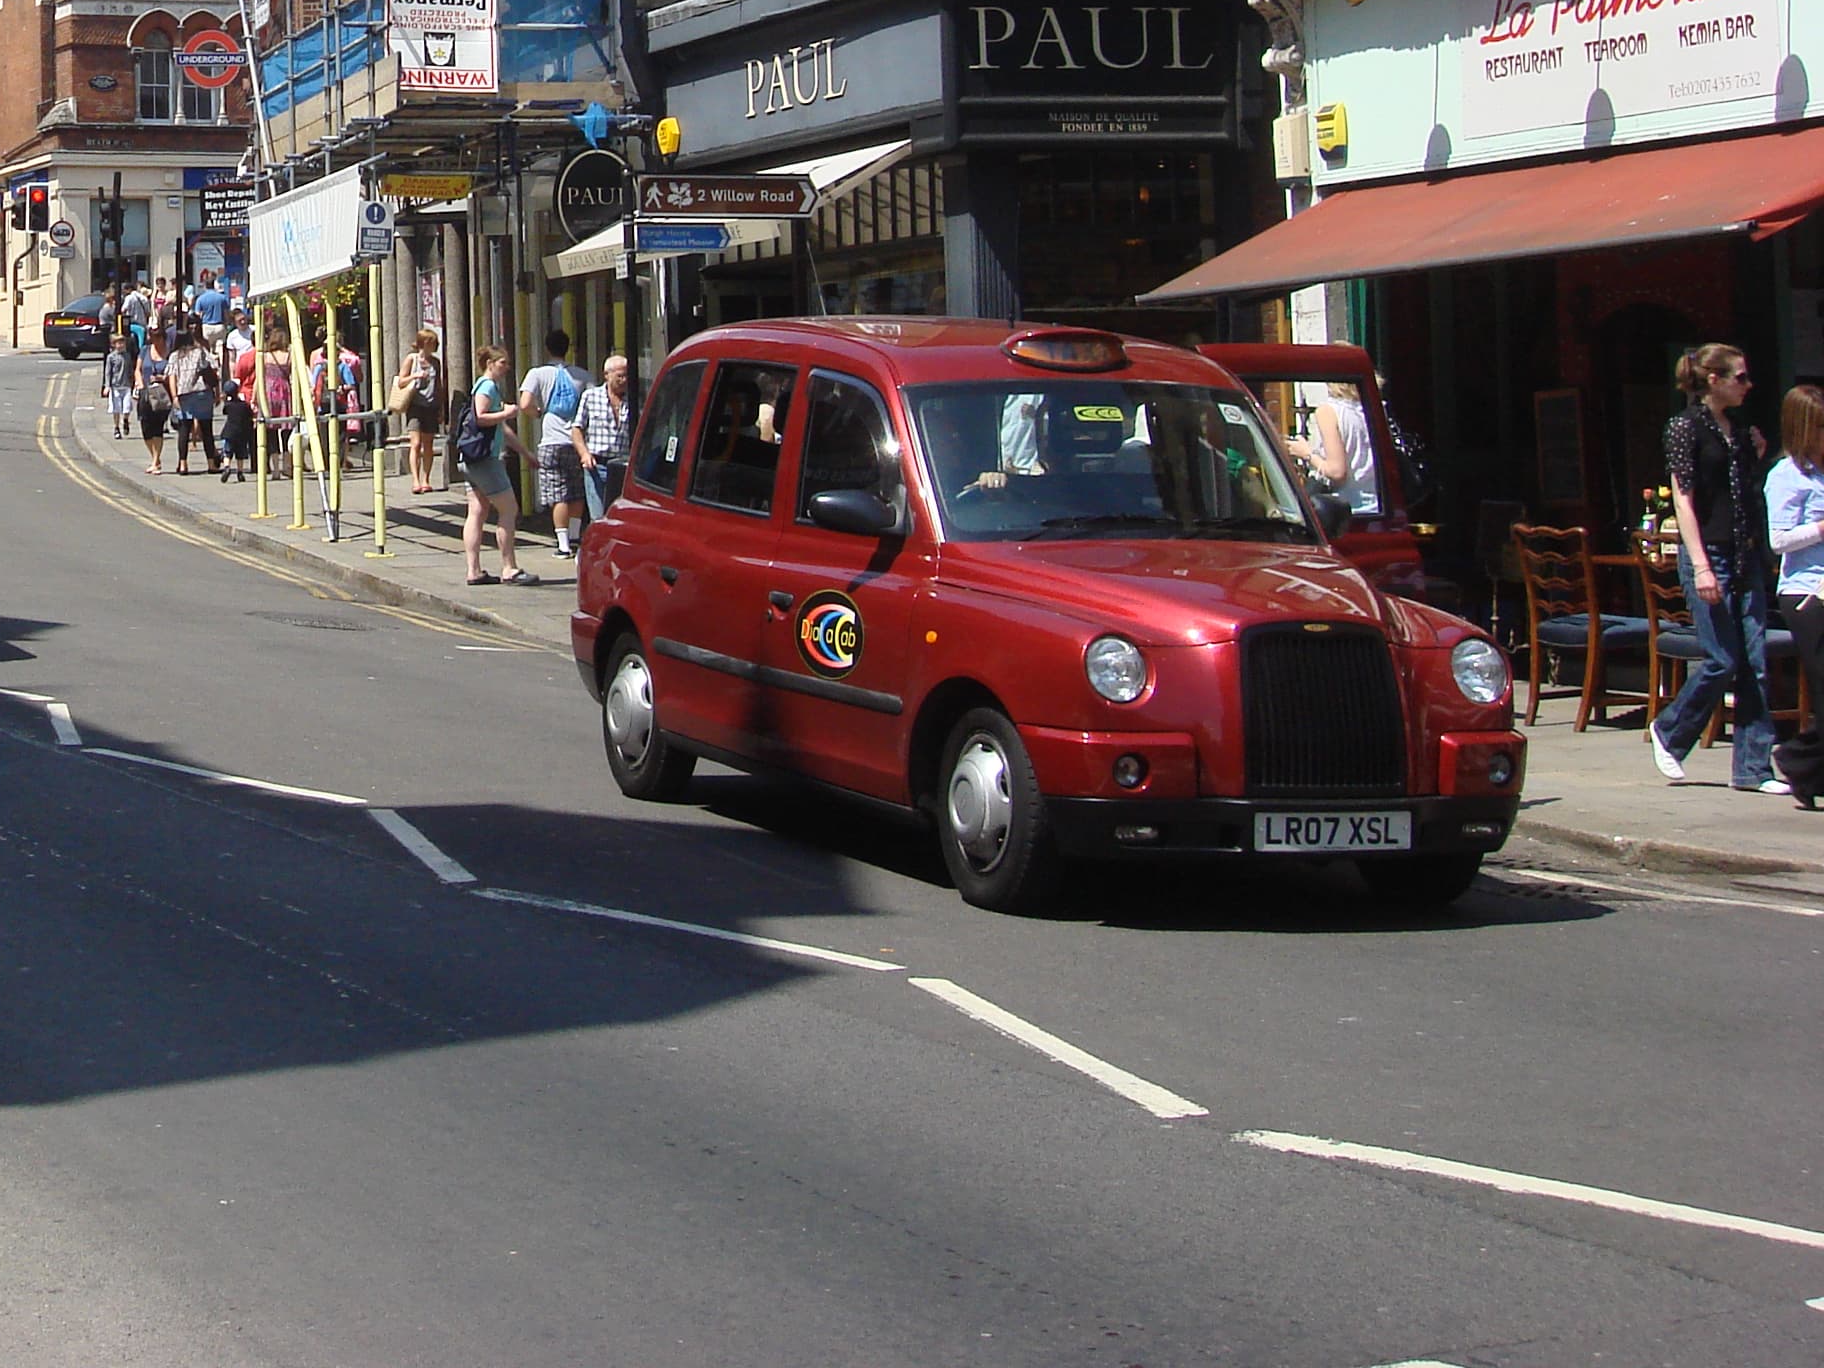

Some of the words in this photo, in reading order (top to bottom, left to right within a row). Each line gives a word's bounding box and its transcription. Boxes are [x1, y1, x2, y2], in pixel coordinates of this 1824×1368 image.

[410, 9, 466, 17] PROTECTED
[969, 6, 1214, 70] PAUL
[1726, 14, 1758, 42] BAR
[1584, 33, 1648, 62] TEAROOM
[178, 55, 245, 64] UNDERGROUND
[1485, 47, 1564, 82] RESTAURANT
[744, 39, 848, 119] PAUL
[1048, 112, 1090, 121] MAISON
[1096, 112, 1109, 121] DE
[1109, 123, 1123, 132] EN
[225, 199, 255, 209] Cuttin
[697, 189, 705, 201] 2
[711, 189, 755, 202] Willow
[760, 189, 795, 202] Road
[1265, 816, 1340, 845] LR07
[1348, 816, 1399, 845] XSL
